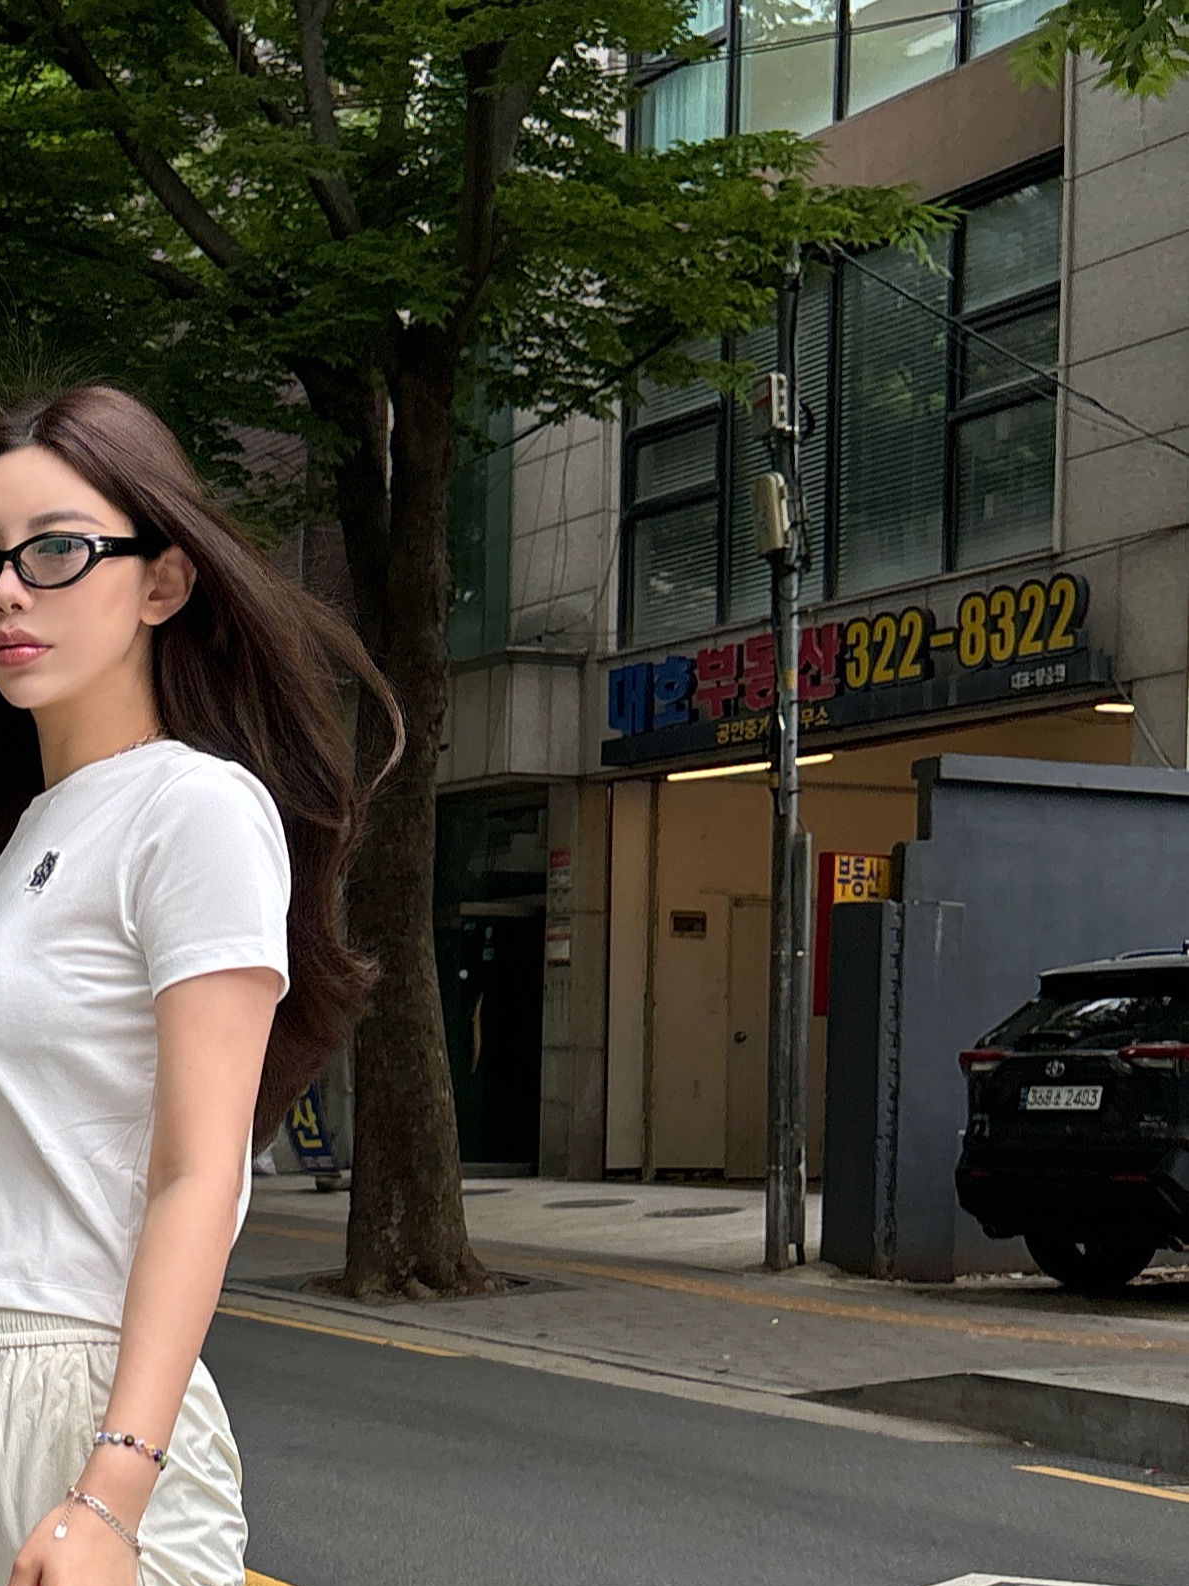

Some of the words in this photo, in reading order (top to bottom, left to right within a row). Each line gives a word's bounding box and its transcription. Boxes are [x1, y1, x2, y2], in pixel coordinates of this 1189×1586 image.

[845, 578, 1077, 689] 322-8322
[716, 706, 829, 744] 공인중개무소
[837, 855, 880, 898] 부동산
[291, 1085, 323, 1149] 산
